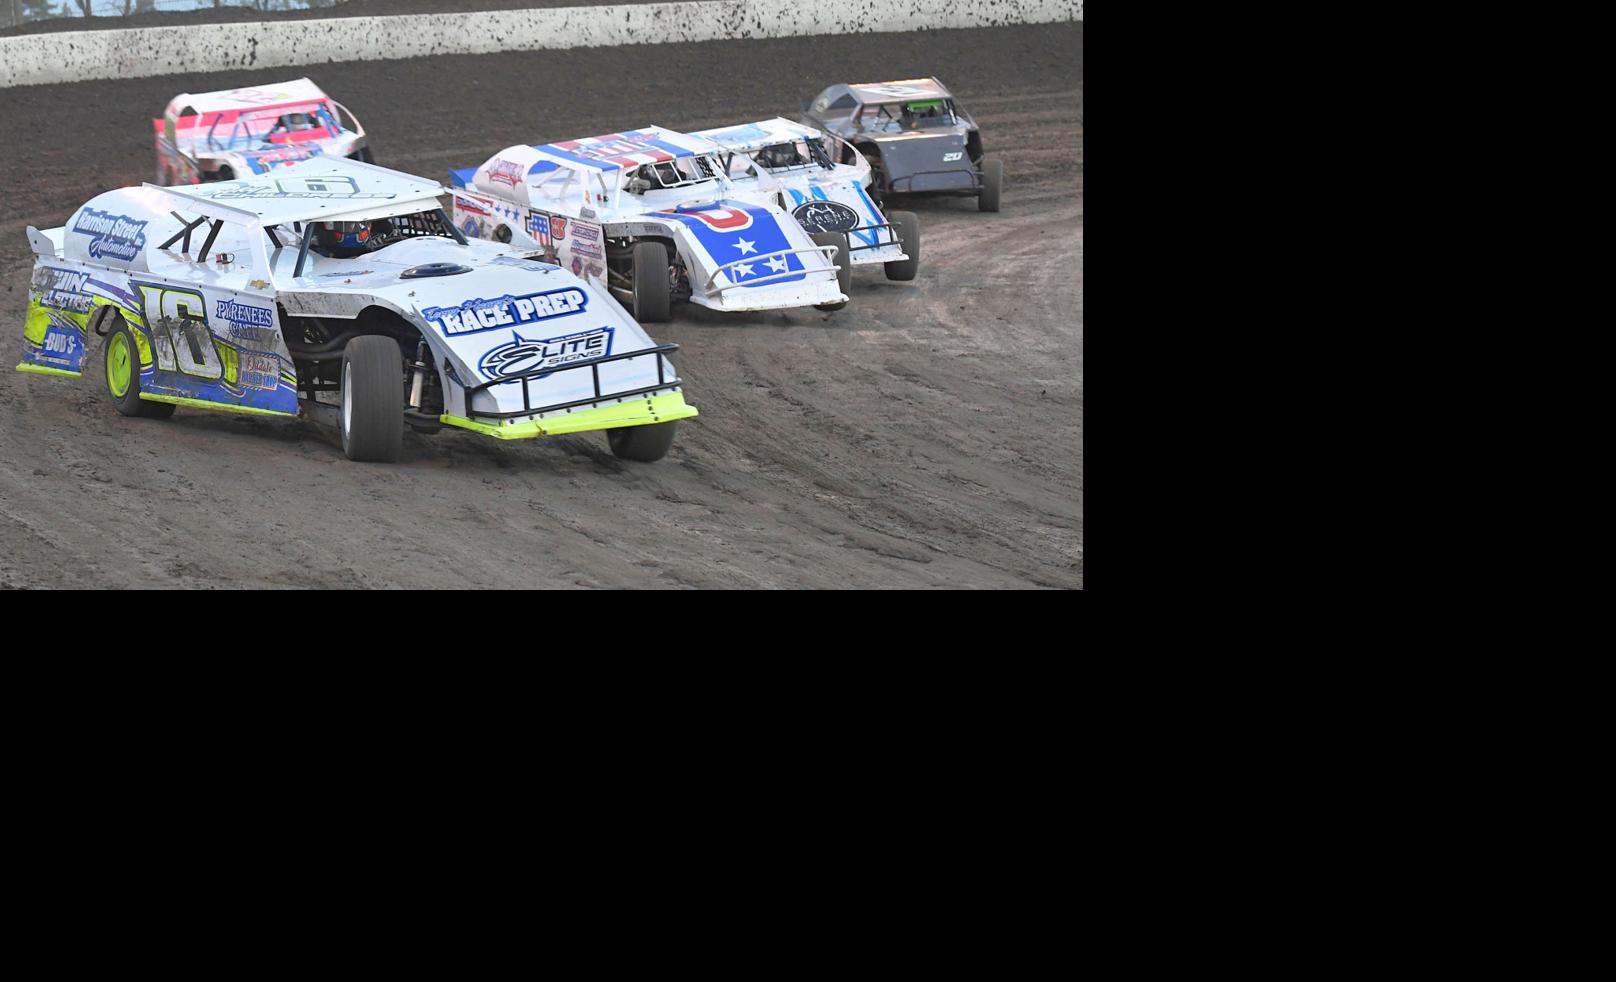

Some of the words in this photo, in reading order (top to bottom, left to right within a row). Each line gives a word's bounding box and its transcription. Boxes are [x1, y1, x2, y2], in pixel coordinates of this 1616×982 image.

[943, 152, 963, 161] 20
[76, 210, 115, 236] Harrison
[111, 217, 143, 241] Street
[91, 233, 136, 257] Automotive
[217, 300, 273, 326] PYRENEES
[441, 302, 515, 335] RACE
[515, 289, 584, 322] PREP
[45, 332, 76, 355] BUD'S
[139, 285, 222, 380] 16
[548, 348, 602, 365] SIGNS
